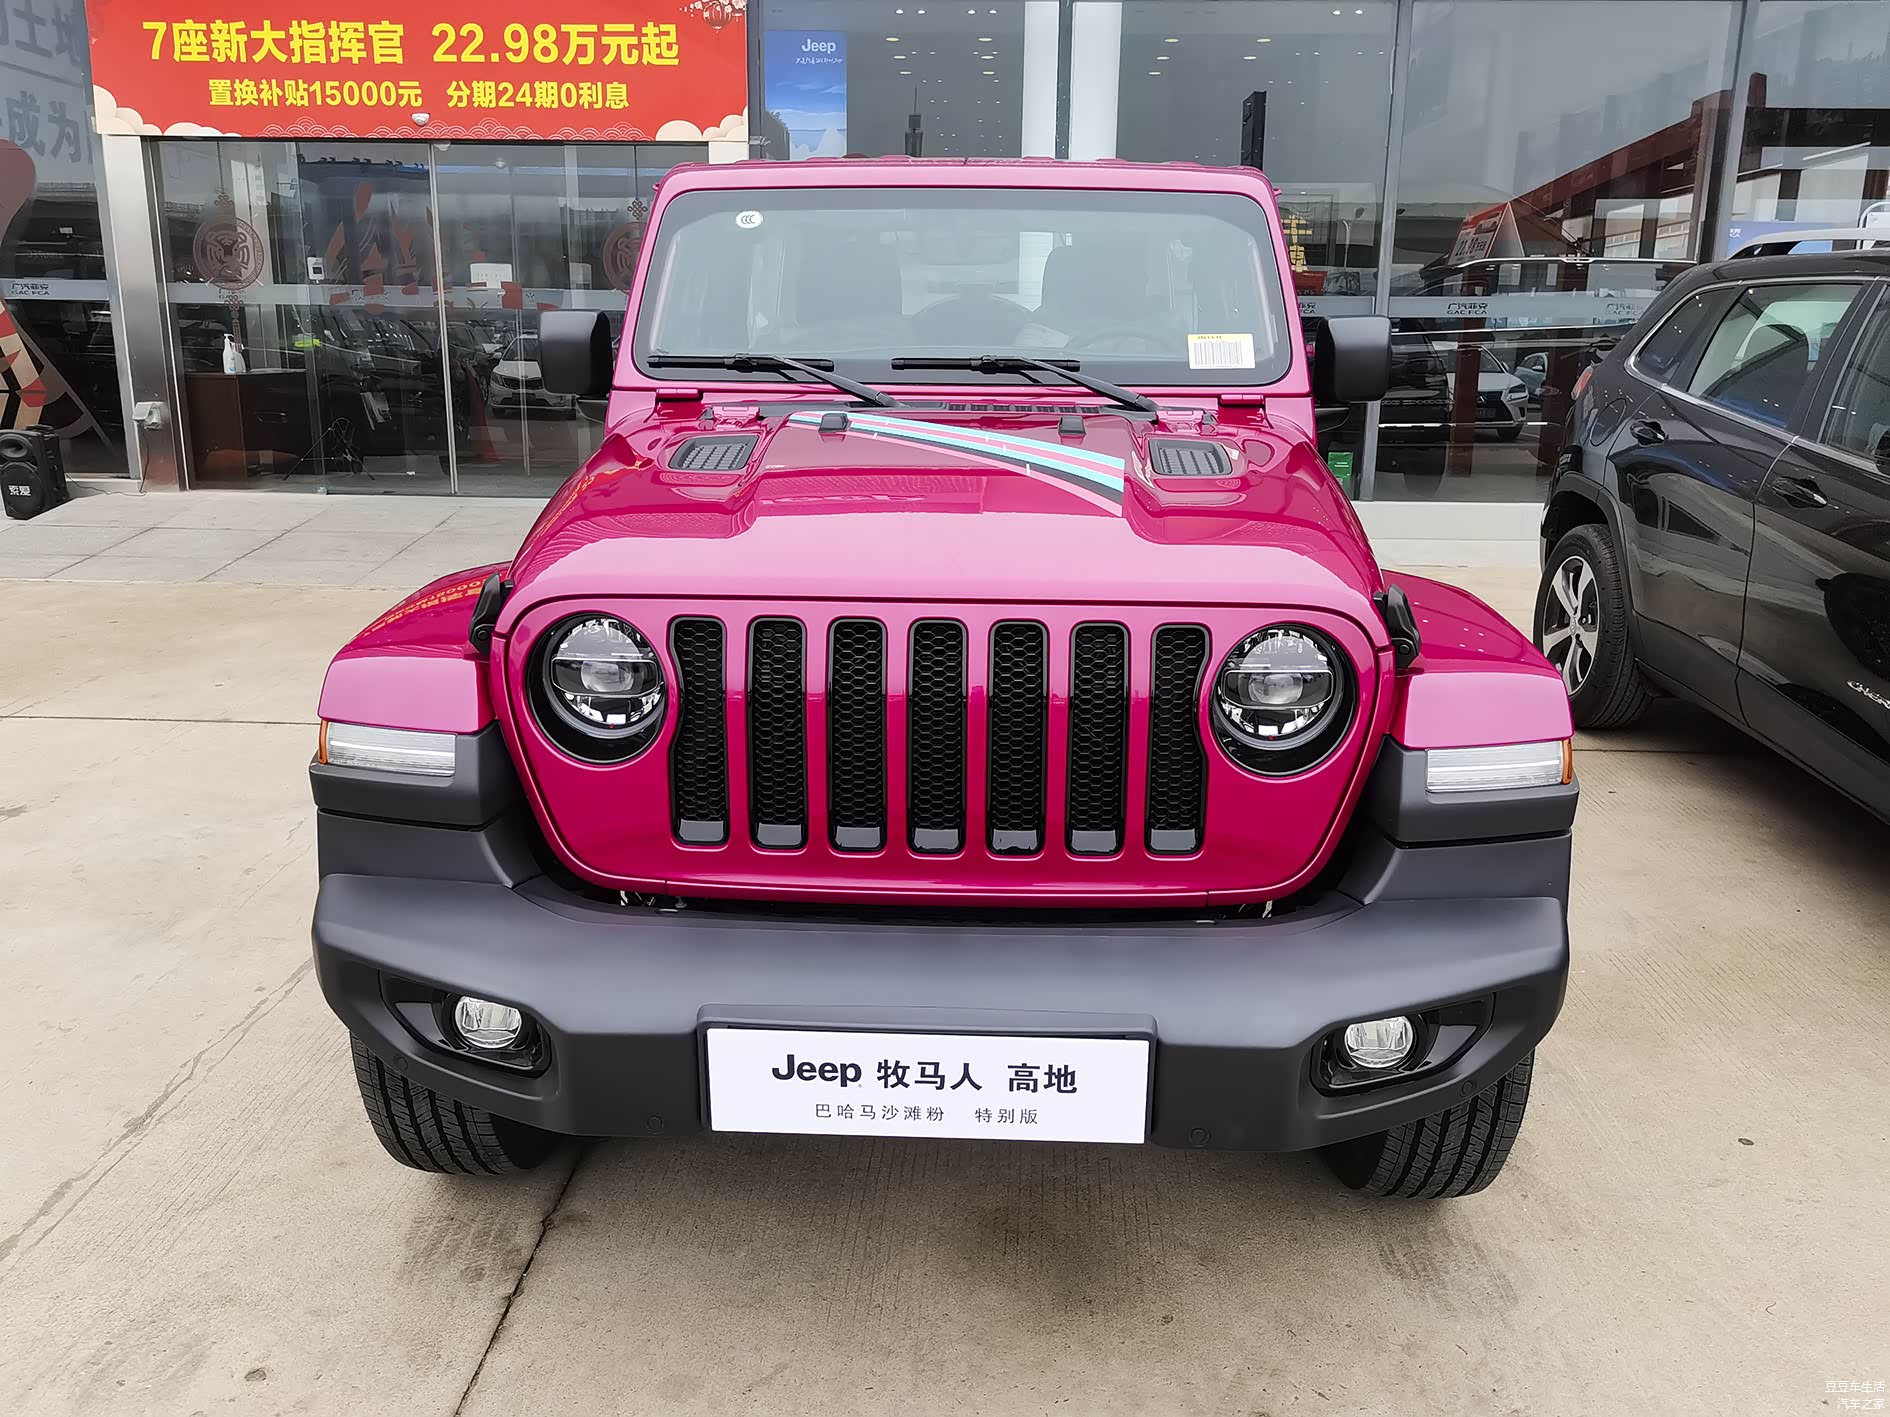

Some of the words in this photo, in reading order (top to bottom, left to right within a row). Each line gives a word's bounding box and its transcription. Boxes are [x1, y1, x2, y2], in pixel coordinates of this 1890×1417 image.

[143, 19, 403, 64] 7座新大指挥官
[432, 22, 679, 65] 22.98万元起
[801, 38, 836, 54] Jeep
[209, 79, 422, 107] 置换补贴15000元
[448, 80, 629, 109] 分期24期0利息
[772, 1054, 861, 1088] Jeep
[876, 1058, 983, 1091] 牧马人
[1007, 1062, 1078, 1094] 高地
[814, 1103, 945, 1122] 巴哈马沙滩粉
[974, 1107, 1038, 1124] 特别版
